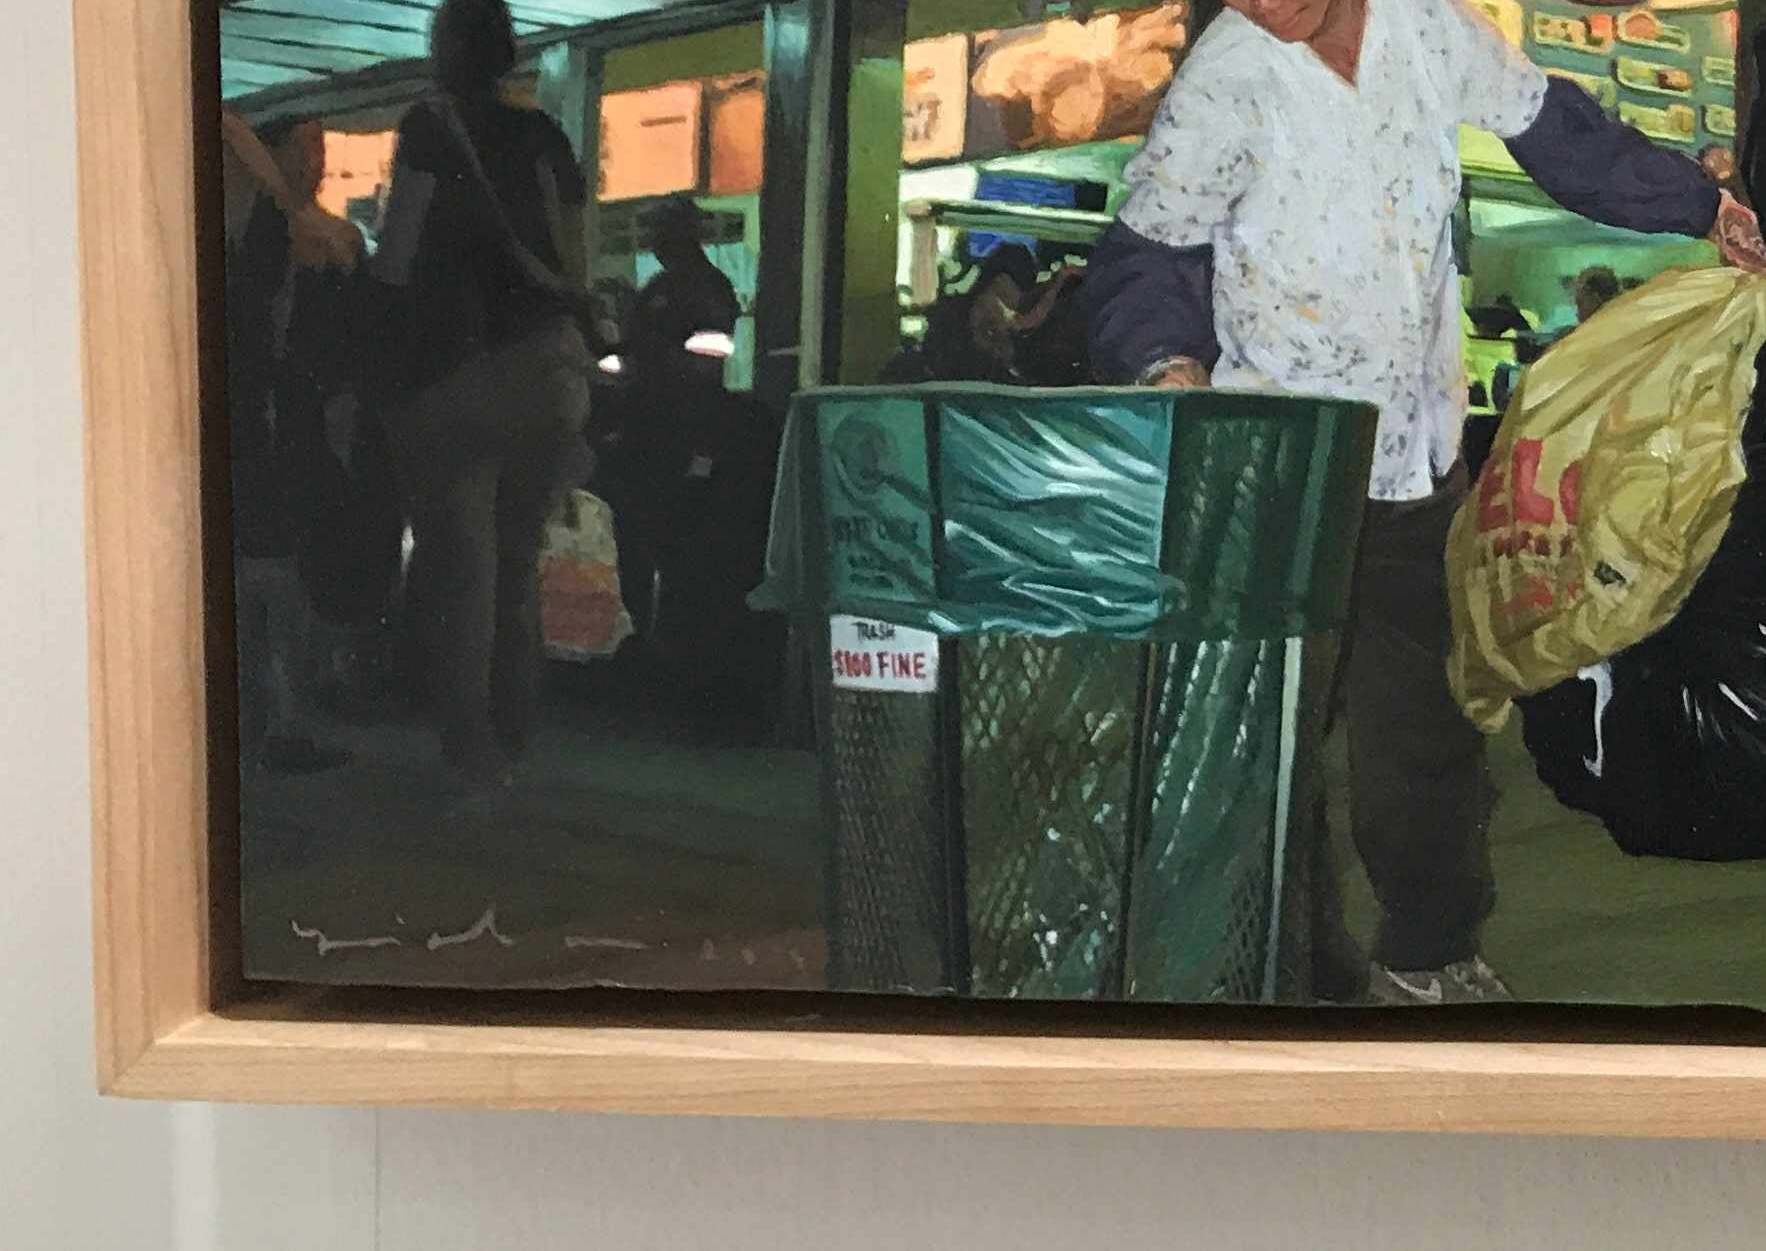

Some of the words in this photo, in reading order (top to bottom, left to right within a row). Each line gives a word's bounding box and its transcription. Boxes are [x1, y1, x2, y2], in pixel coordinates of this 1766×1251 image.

[850, 619, 896, 641] TRASH
[834, 649, 872, 678] $100
[876, 651, 926, 680] FINE
